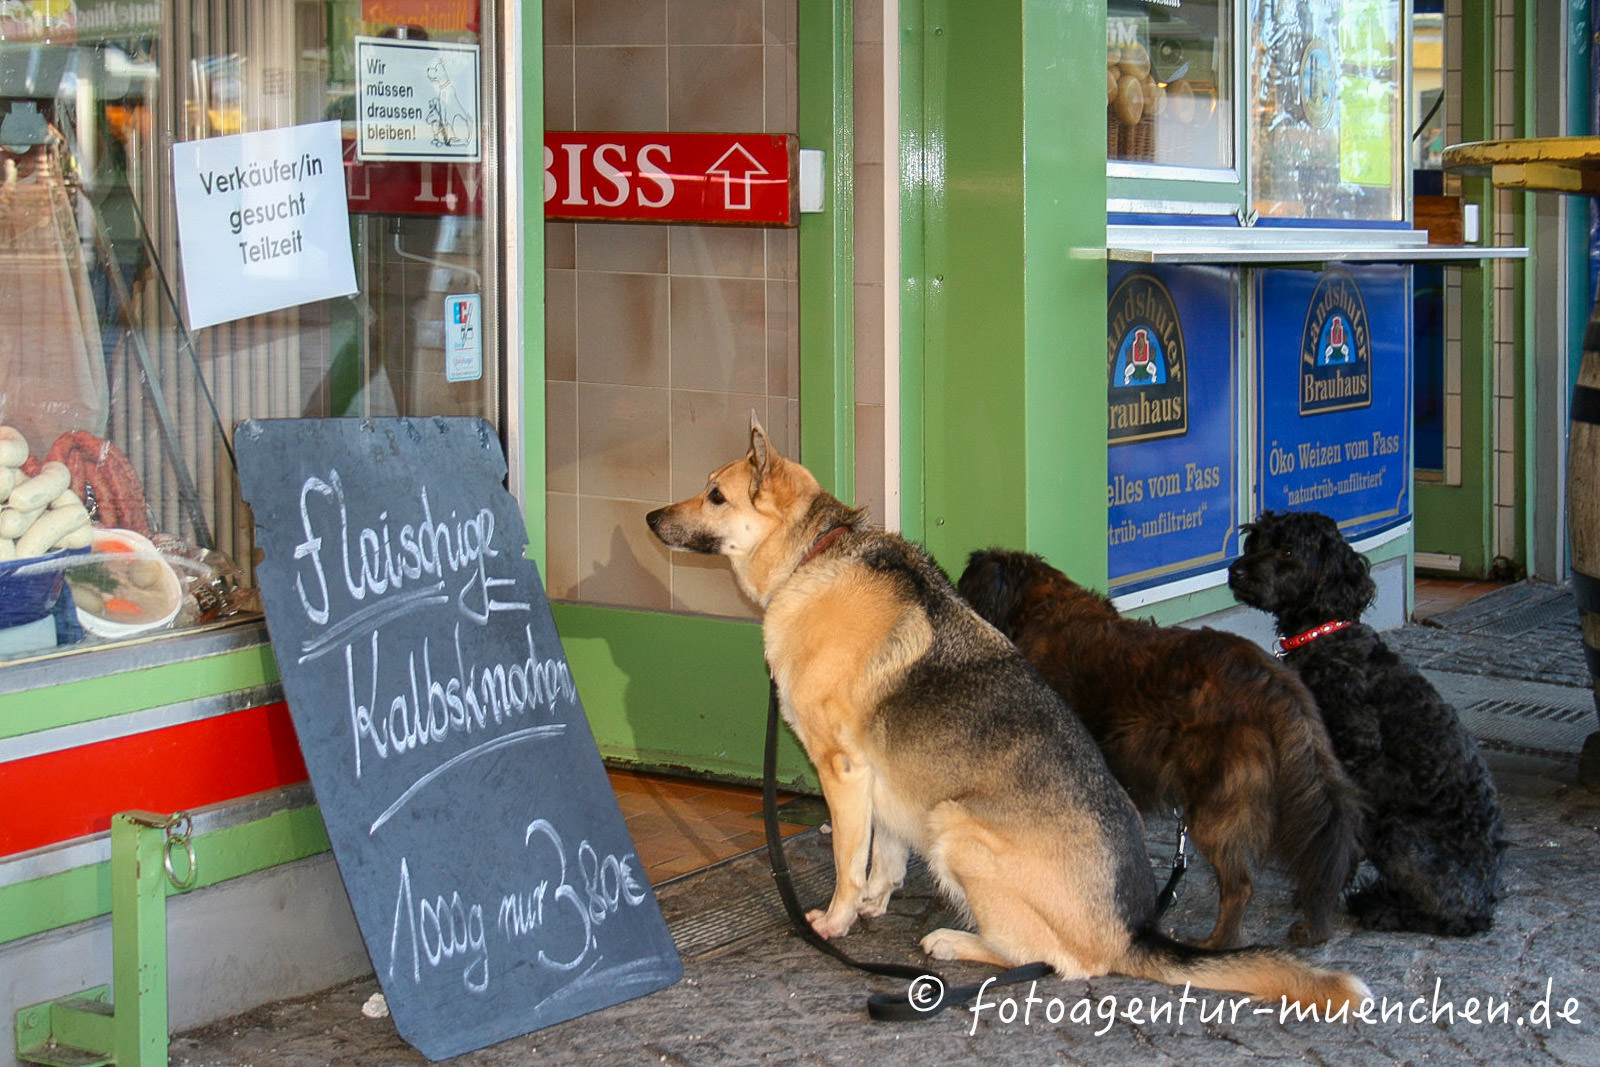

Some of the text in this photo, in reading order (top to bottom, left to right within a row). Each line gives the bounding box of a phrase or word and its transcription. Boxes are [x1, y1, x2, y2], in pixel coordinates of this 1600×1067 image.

[367, 59, 386, 75] Wir
[367, 81, 414, 97] müssen
[367, 102, 422, 119] draussen
[367, 124, 416, 140] bleiben!
[200, 153, 323, 195] Verkäufer/in
[230, 192, 306, 235] gesucht
[239, 229, 303, 265] Teilzeit
[1107, 287, 1181, 382] andshuter
[1304, 280, 1367, 369] Landshuter
[1304, 369, 1367, 404] Brauhaus
[1107, 392, 1182, 430] rauhaus
[1269, 431, 1400, 476] Öko Weizen vom Fass
[1107, 463, 1220, 508] elles vom Fass
[1107, 502, 1208, 547] trüb-unfiltriert“
[346, 621, 576, 778] Kalbsknochen
[498, 879, 549, 942] nur
